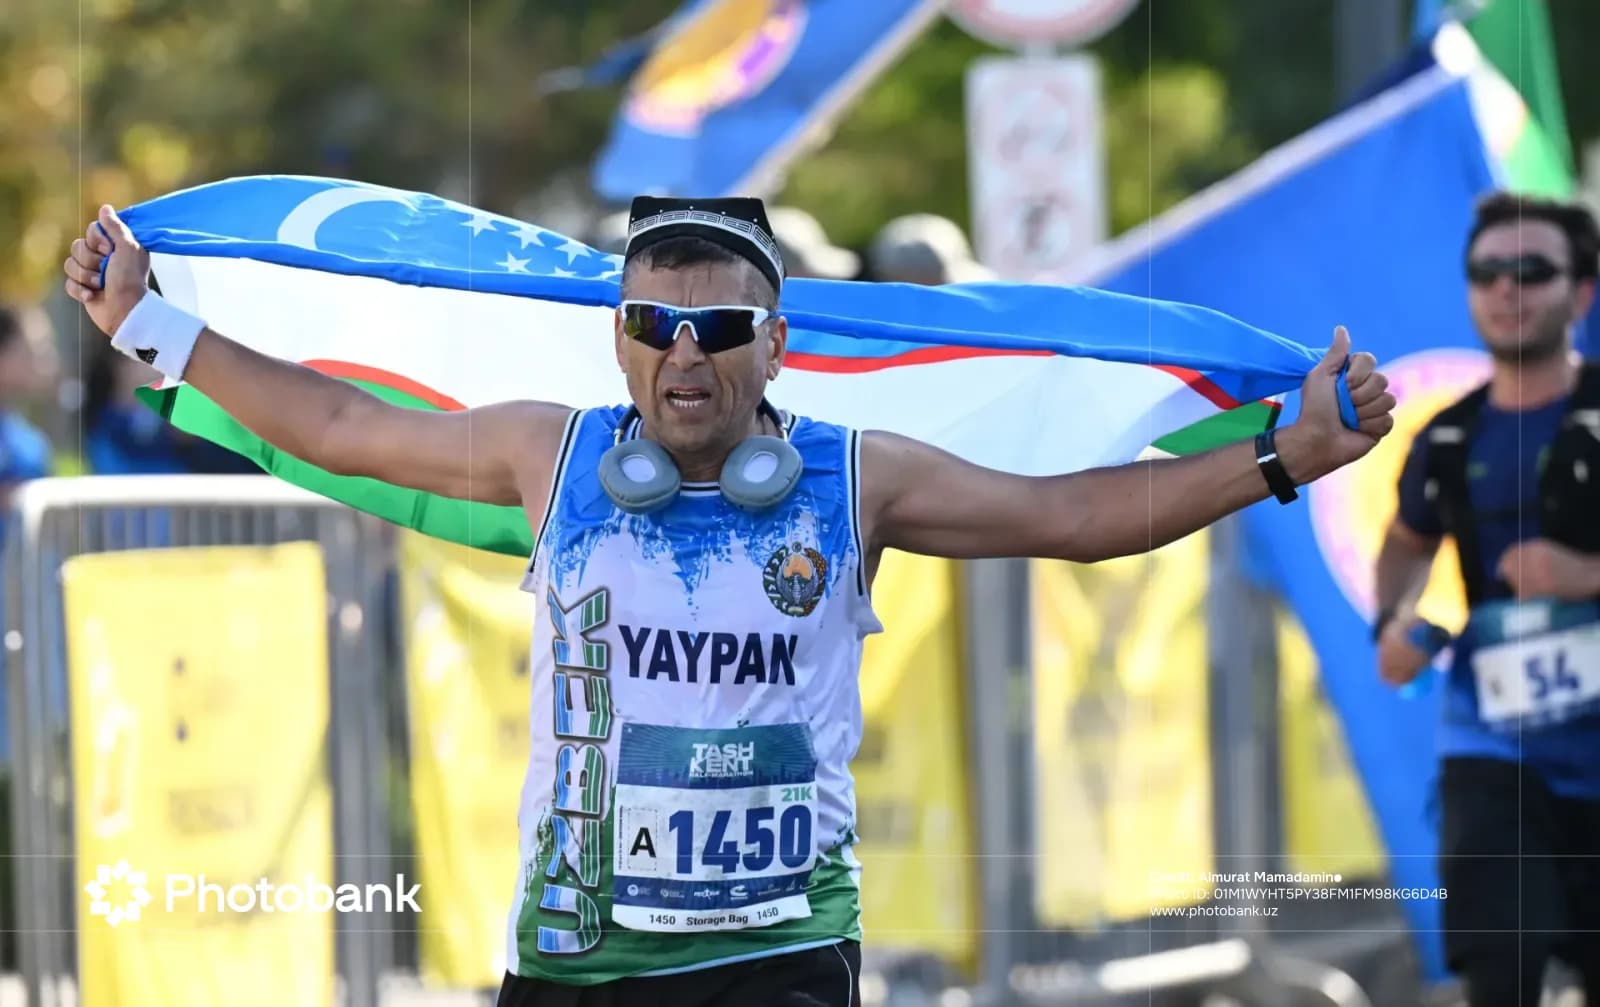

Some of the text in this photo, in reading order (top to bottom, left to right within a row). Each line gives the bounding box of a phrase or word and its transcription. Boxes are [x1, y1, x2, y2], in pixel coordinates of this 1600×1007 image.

[618, 625, 799, 686] YAYPAN
[1524, 648, 1580, 701] 54
[690, 757, 750, 773] KENT
[692, 741, 754, 760] TASH
[537, 584, 611, 957] UZBEK
[781, 786, 813, 802] 21K
[629, 827, 657, 858] A
[668, 804, 812, 875] 1450
[650, 906, 779, 926] 1450 Storage Bag 1450
